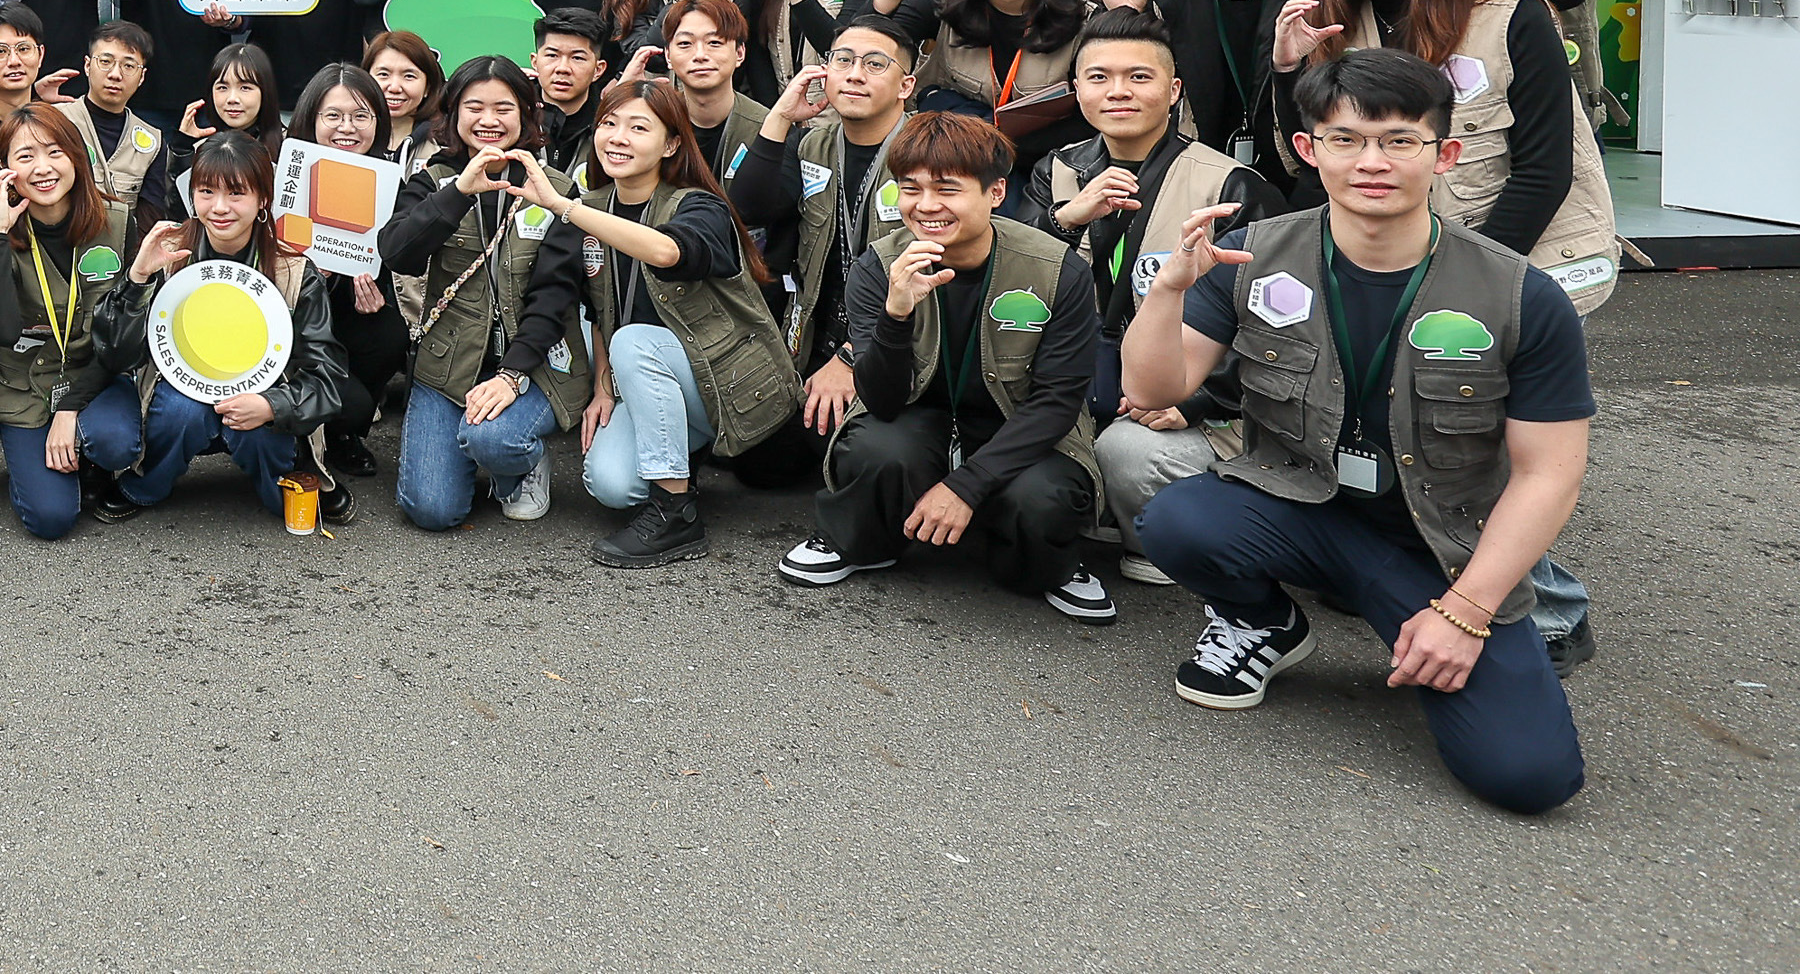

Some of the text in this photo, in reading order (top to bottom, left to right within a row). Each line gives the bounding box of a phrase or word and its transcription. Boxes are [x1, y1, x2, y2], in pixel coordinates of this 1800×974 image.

[279, 149, 305, 209] 營運企劃
[313, 244, 375, 265] MANAGEMENT
[315, 234, 364, 252] OPERATION
[200, 265, 268, 296] 業務菁英
[156, 324, 277, 396] SALES REPRESENTATIVE
